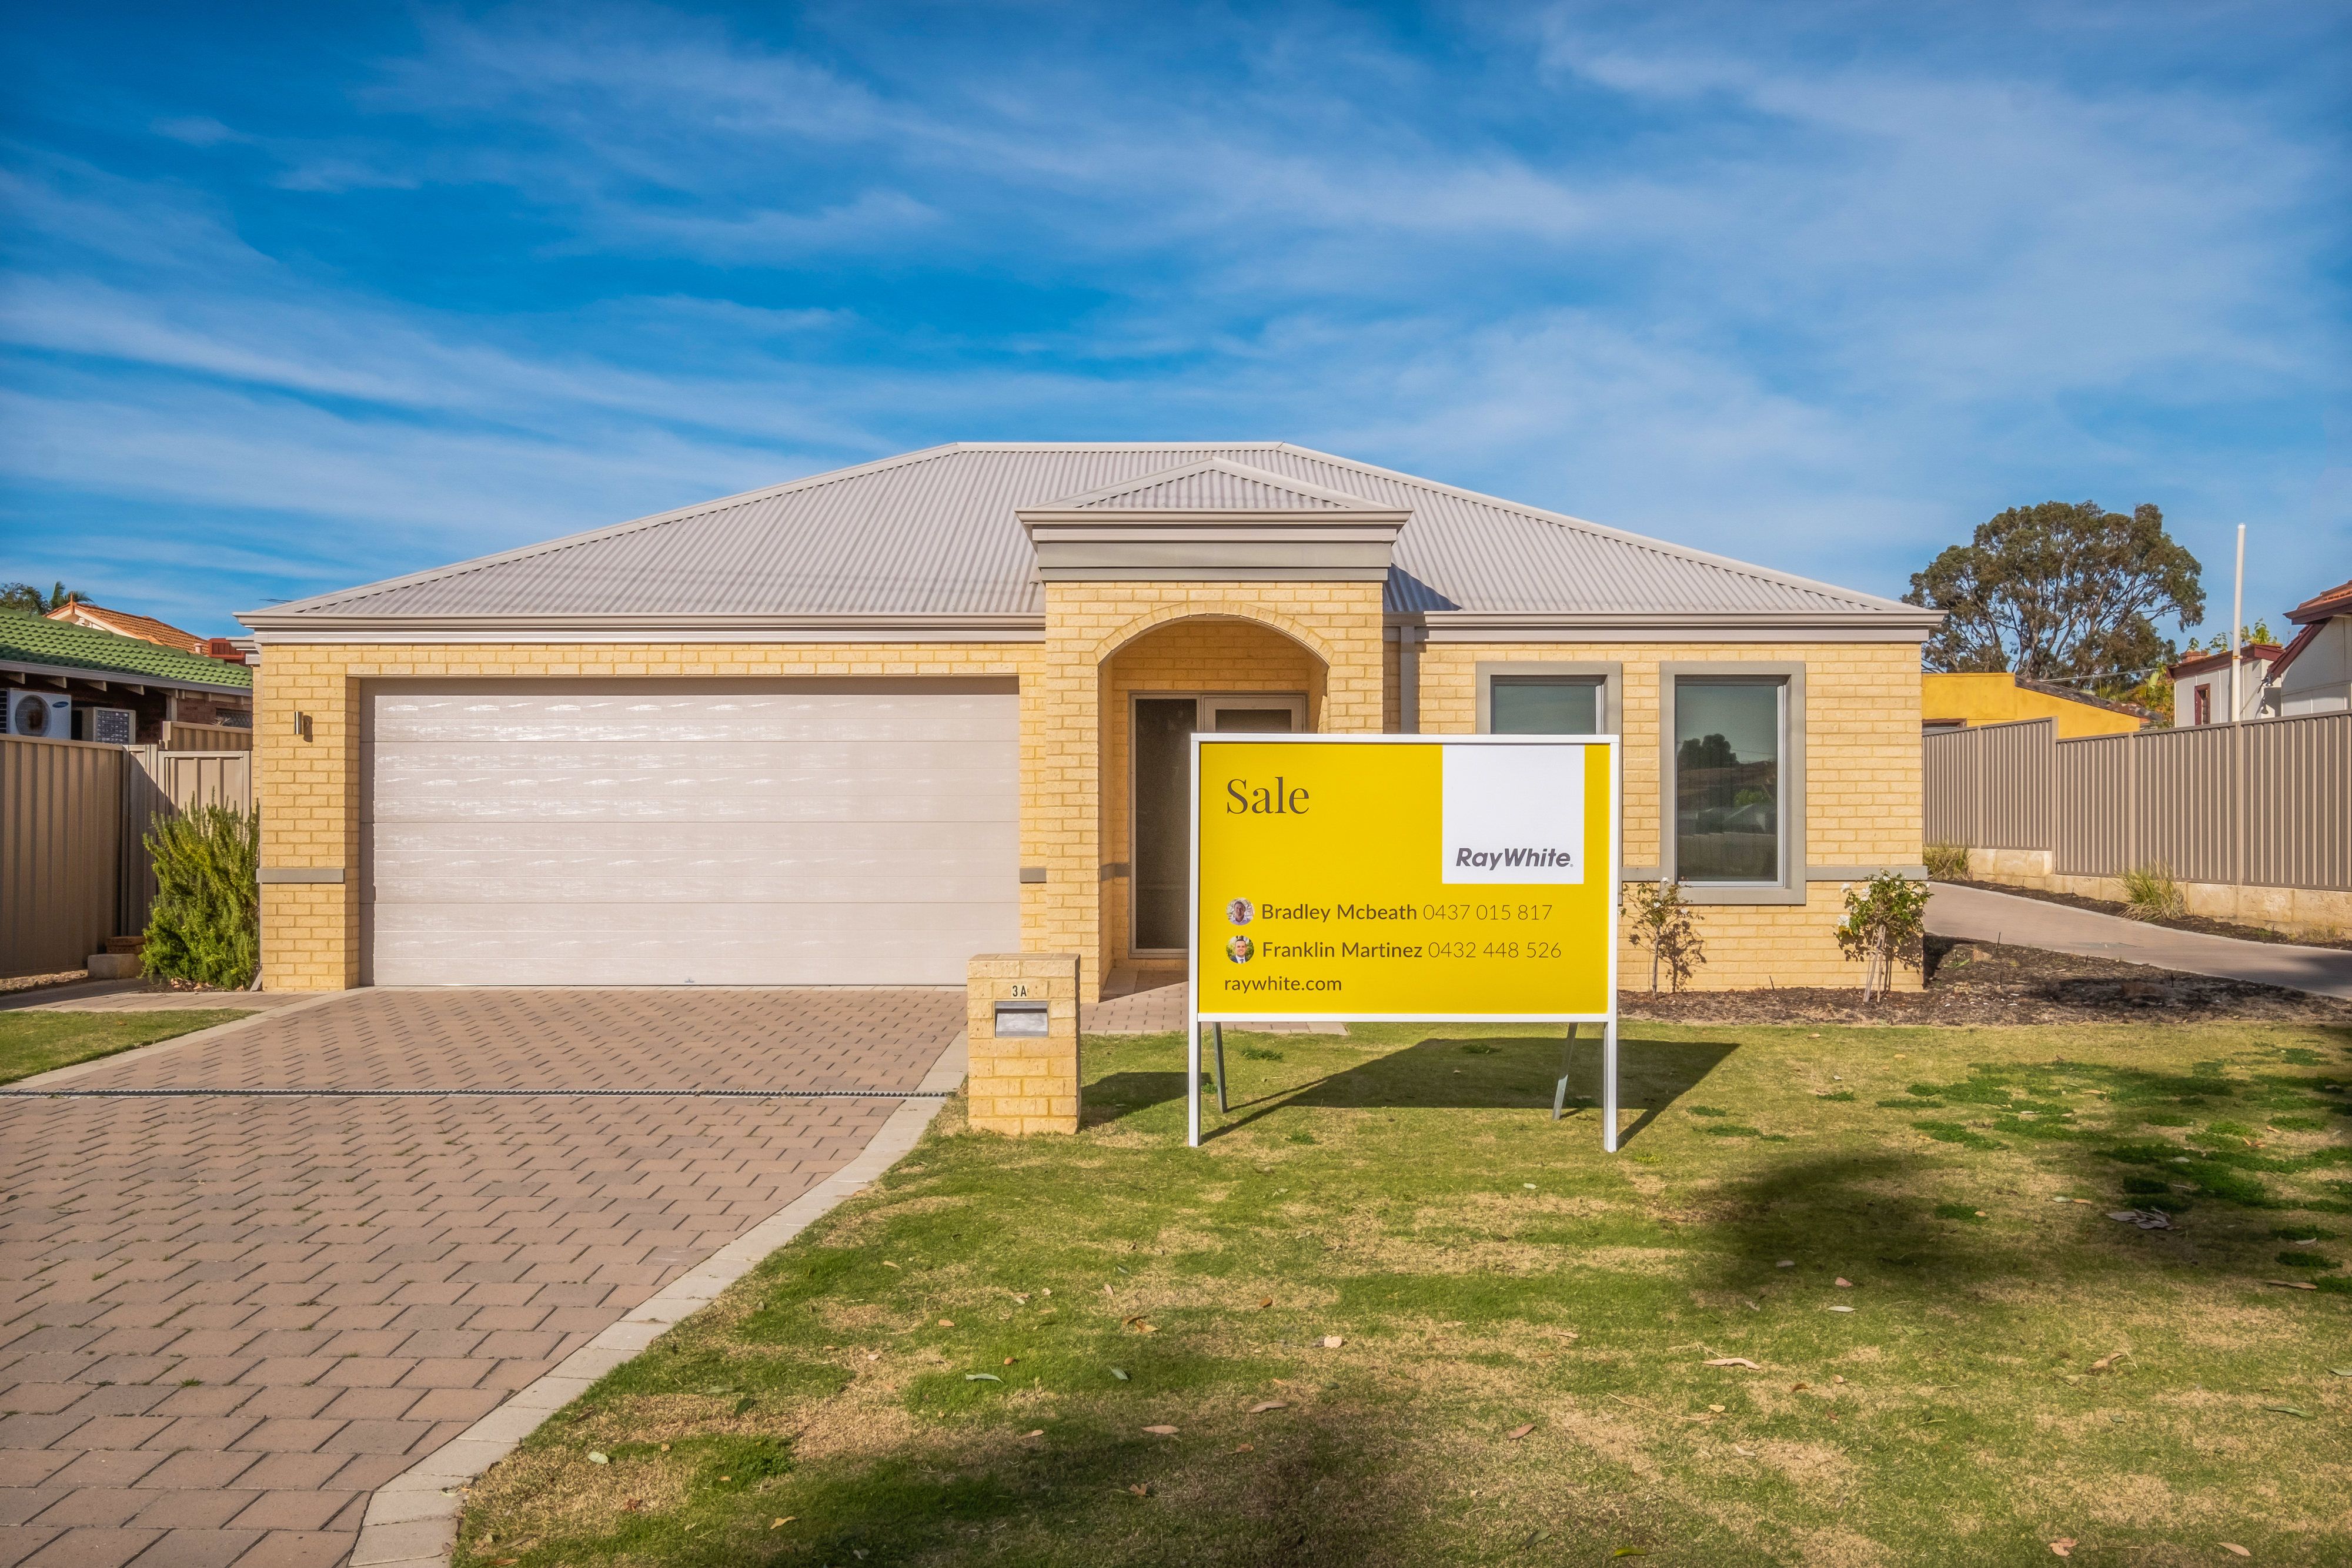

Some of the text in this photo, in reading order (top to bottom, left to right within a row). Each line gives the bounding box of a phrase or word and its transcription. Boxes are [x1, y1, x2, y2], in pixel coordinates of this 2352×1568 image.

[1226, 776, 1310, 815] Sale
[1262, 903, 1553, 923] Bradley Mcbeath 0437 015 817
[1262, 941, 1562, 958] Franklin Martinez 0432 448 526
[1224, 975, 1342, 994] raywhite.com
